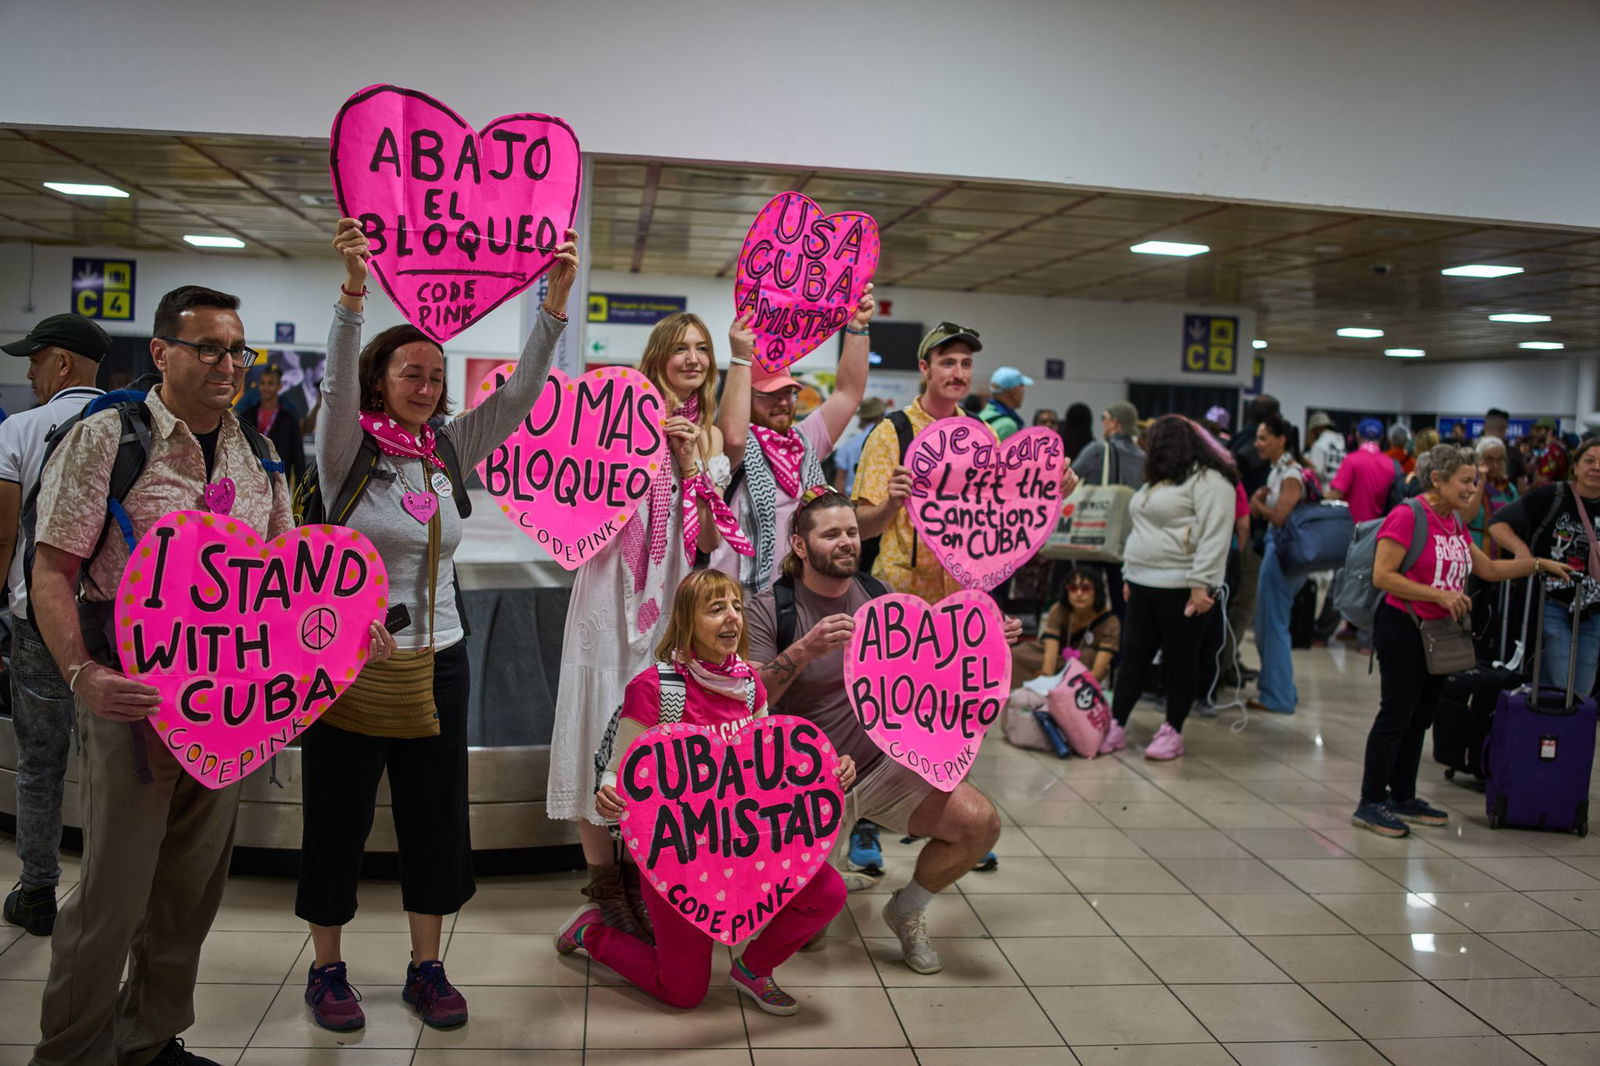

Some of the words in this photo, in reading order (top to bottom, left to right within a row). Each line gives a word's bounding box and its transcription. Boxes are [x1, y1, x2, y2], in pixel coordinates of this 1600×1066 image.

[369, 127, 551, 184] ABAJO
[424, 189, 465, 220] EL
[775, 195, 862, 265] USA
[358, 213, 557, 261] BLOQUEO
[417, 280, 477, 303] CODE
[745, 240, 853, 304] CUBA
[77, 289, 98, 317] C
[110, 296, 122, 313] 4
[418, 304, 475, 327] PINK
[739, 280, 848, 340] AMISTAD
[1187, 344, 1205, 370] C
[495, 373, 561, 436] O
[571, 379, 660, 456] MAS
[486, 444, 651, 507] BLOQUEO
[935, 463, 1005, 505] Lift
[1016, 468, 1057, 500] the
[920, 500, 1048, 536] Sanctions
[941, 532, 963, 549] on
[967, 526, 1031, 559] CUBA
[143, 527, 175, 609] I
[190, 540, 368, 614] STAND
[133, 622, 270, 673] WITH
[859, 601, 986, 669] ABAJO
[181, 667, 337, 725] CUBA
[962, 656, 999, 692] EL
[852, 675, 1000, 739] BLOQUEO
[646, 789, 841, 870] AMISTAD
